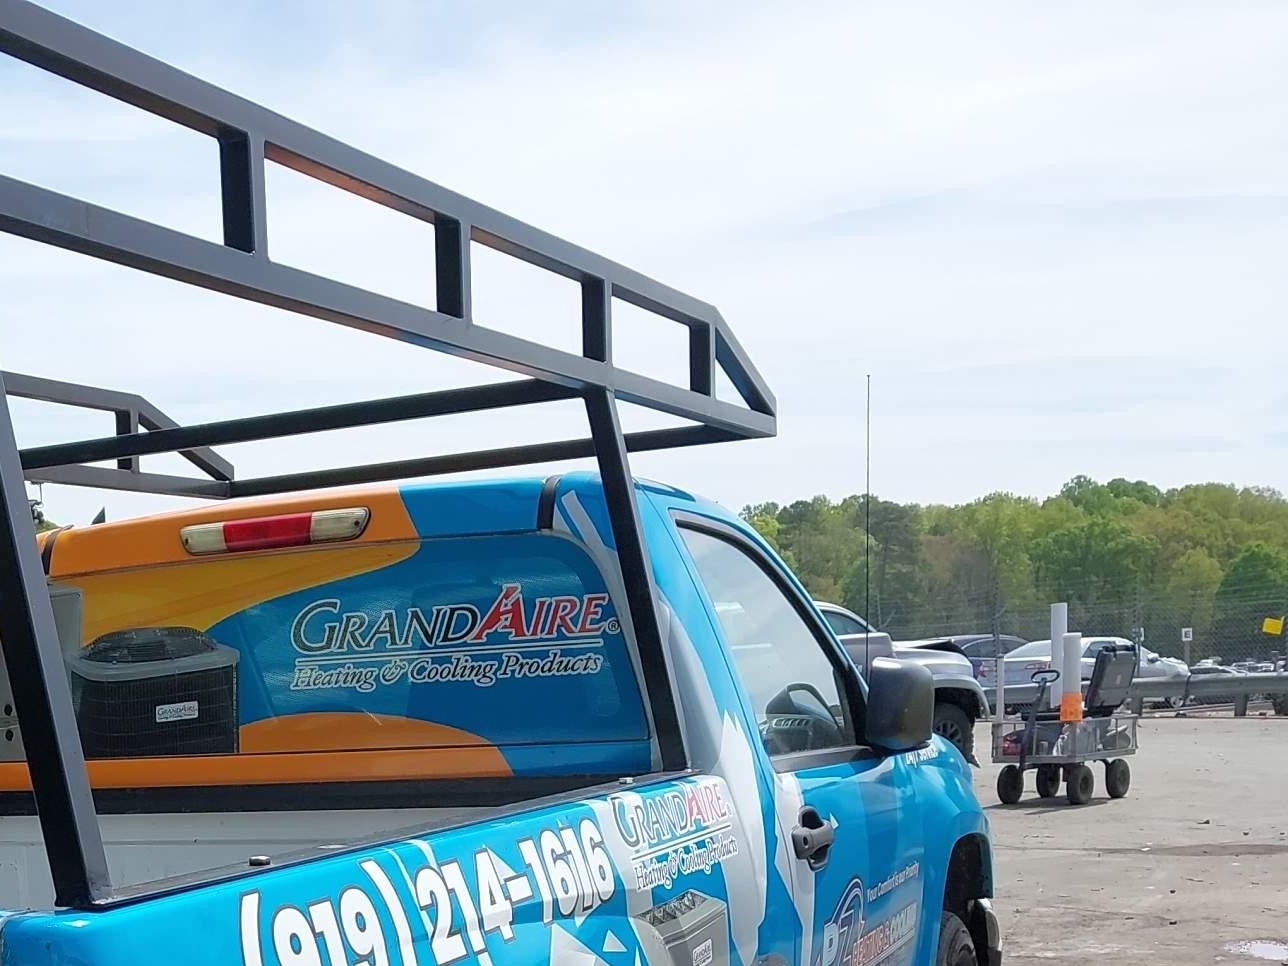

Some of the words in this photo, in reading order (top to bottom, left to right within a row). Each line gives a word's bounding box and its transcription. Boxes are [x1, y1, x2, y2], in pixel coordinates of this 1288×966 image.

[291, 663, 376, 692] Heating
[380, 659, 409, 684] &
[410, 653, 493, 685] Cooling
[499, 651, 602, 677] Products
[634, 855, 673, 890] Heating
[678, 844, 712, 875] Cooling
[707, 835, 739, 863] Products
